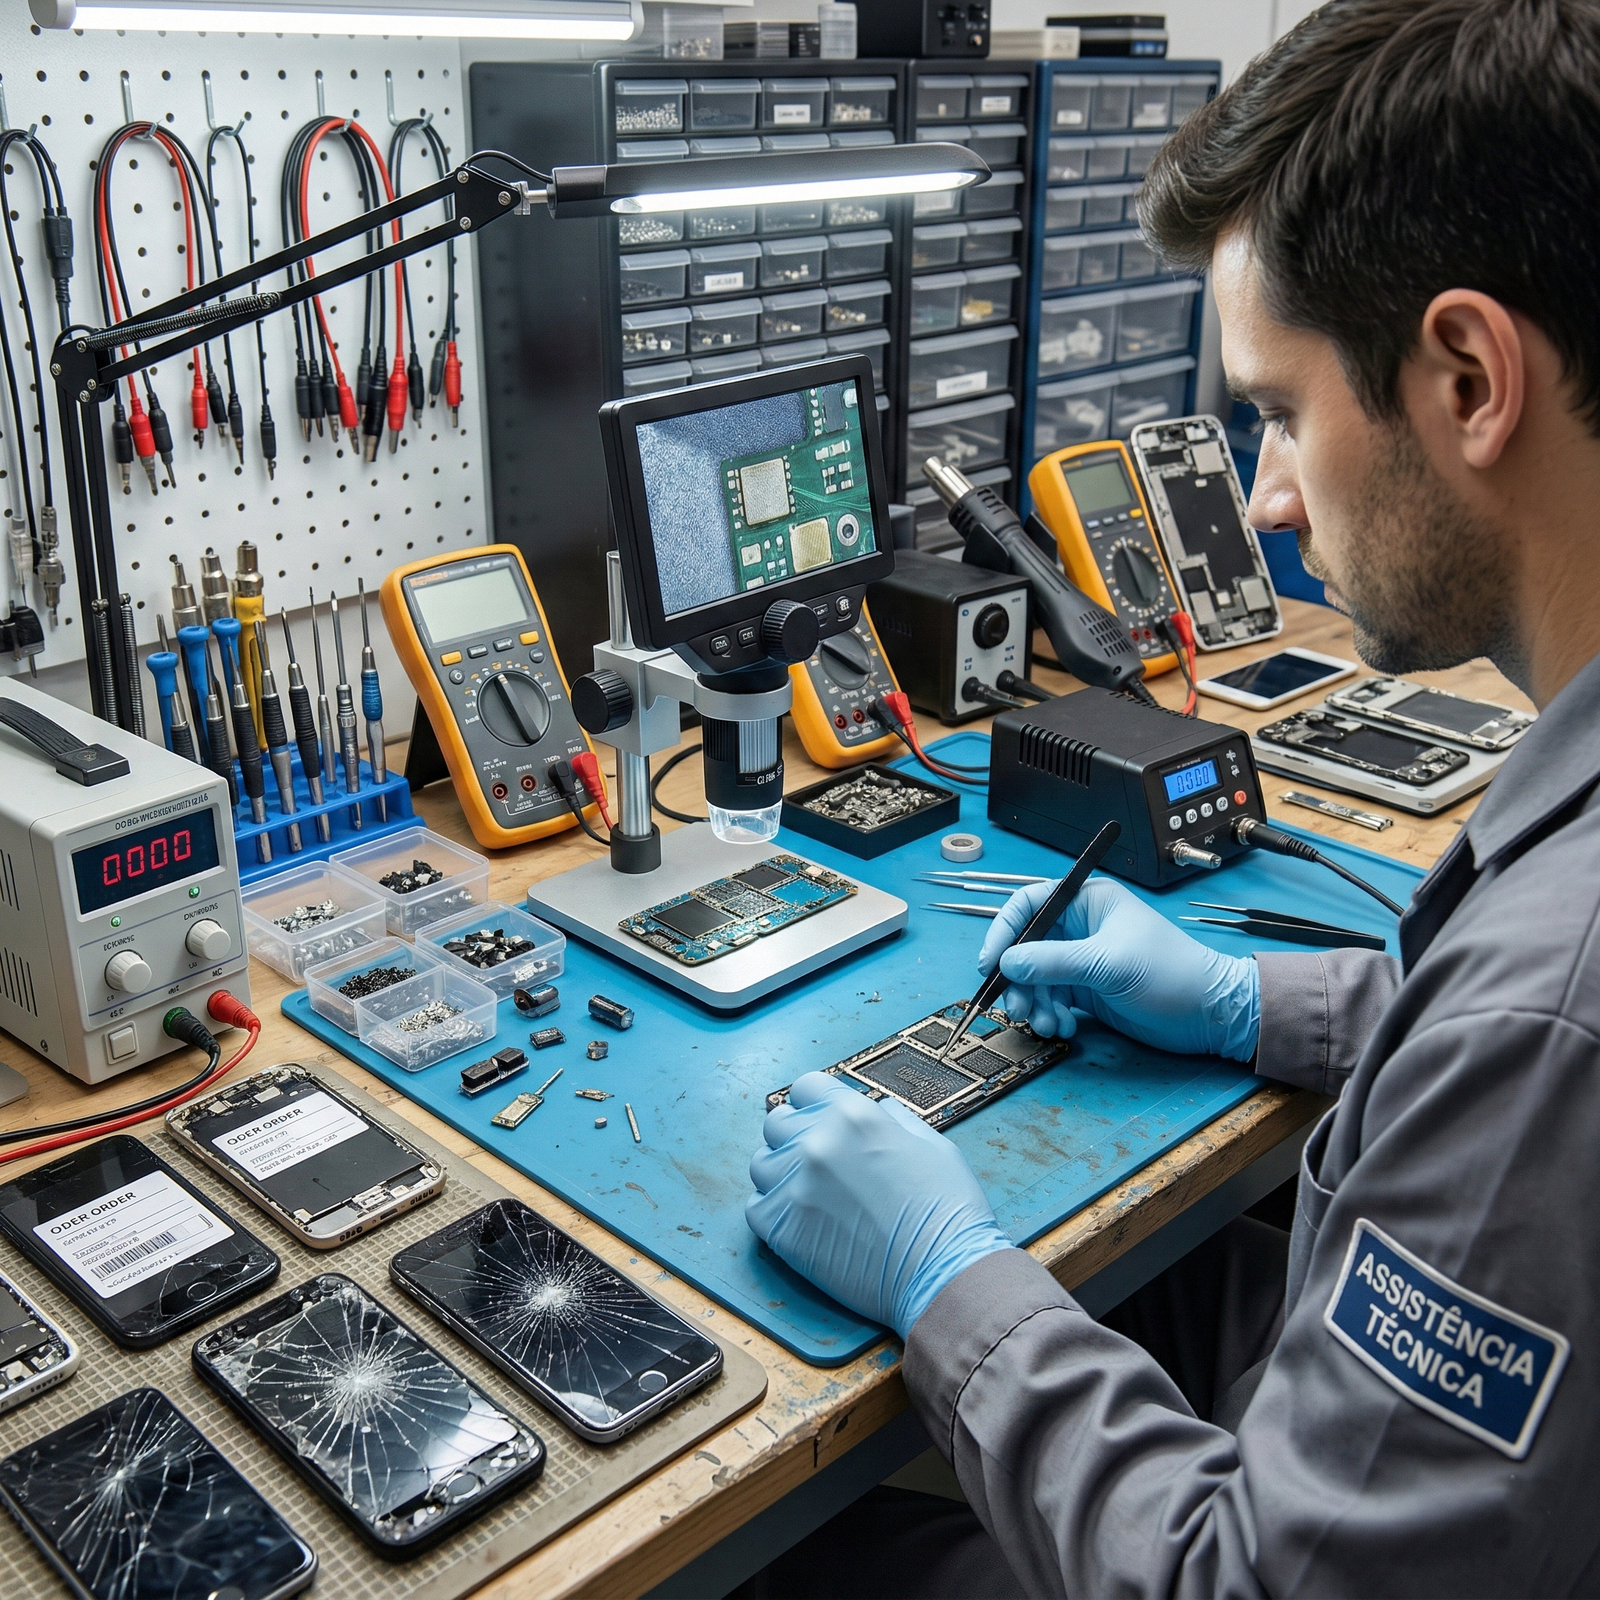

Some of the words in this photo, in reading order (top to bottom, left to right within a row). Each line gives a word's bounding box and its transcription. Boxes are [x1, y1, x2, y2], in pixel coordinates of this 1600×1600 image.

[102, 829, 192, 886] 0000
[262, 1108, 304, 1130] ORDER
[50, 1213, 90, 1235] ODER
[90, 1191, 137, 1216] ORDER
[1355, 1252, 1534, 1386] ASSISTÊNCIA
[1365, 1303, 1484, 1409] TÉCNICA
